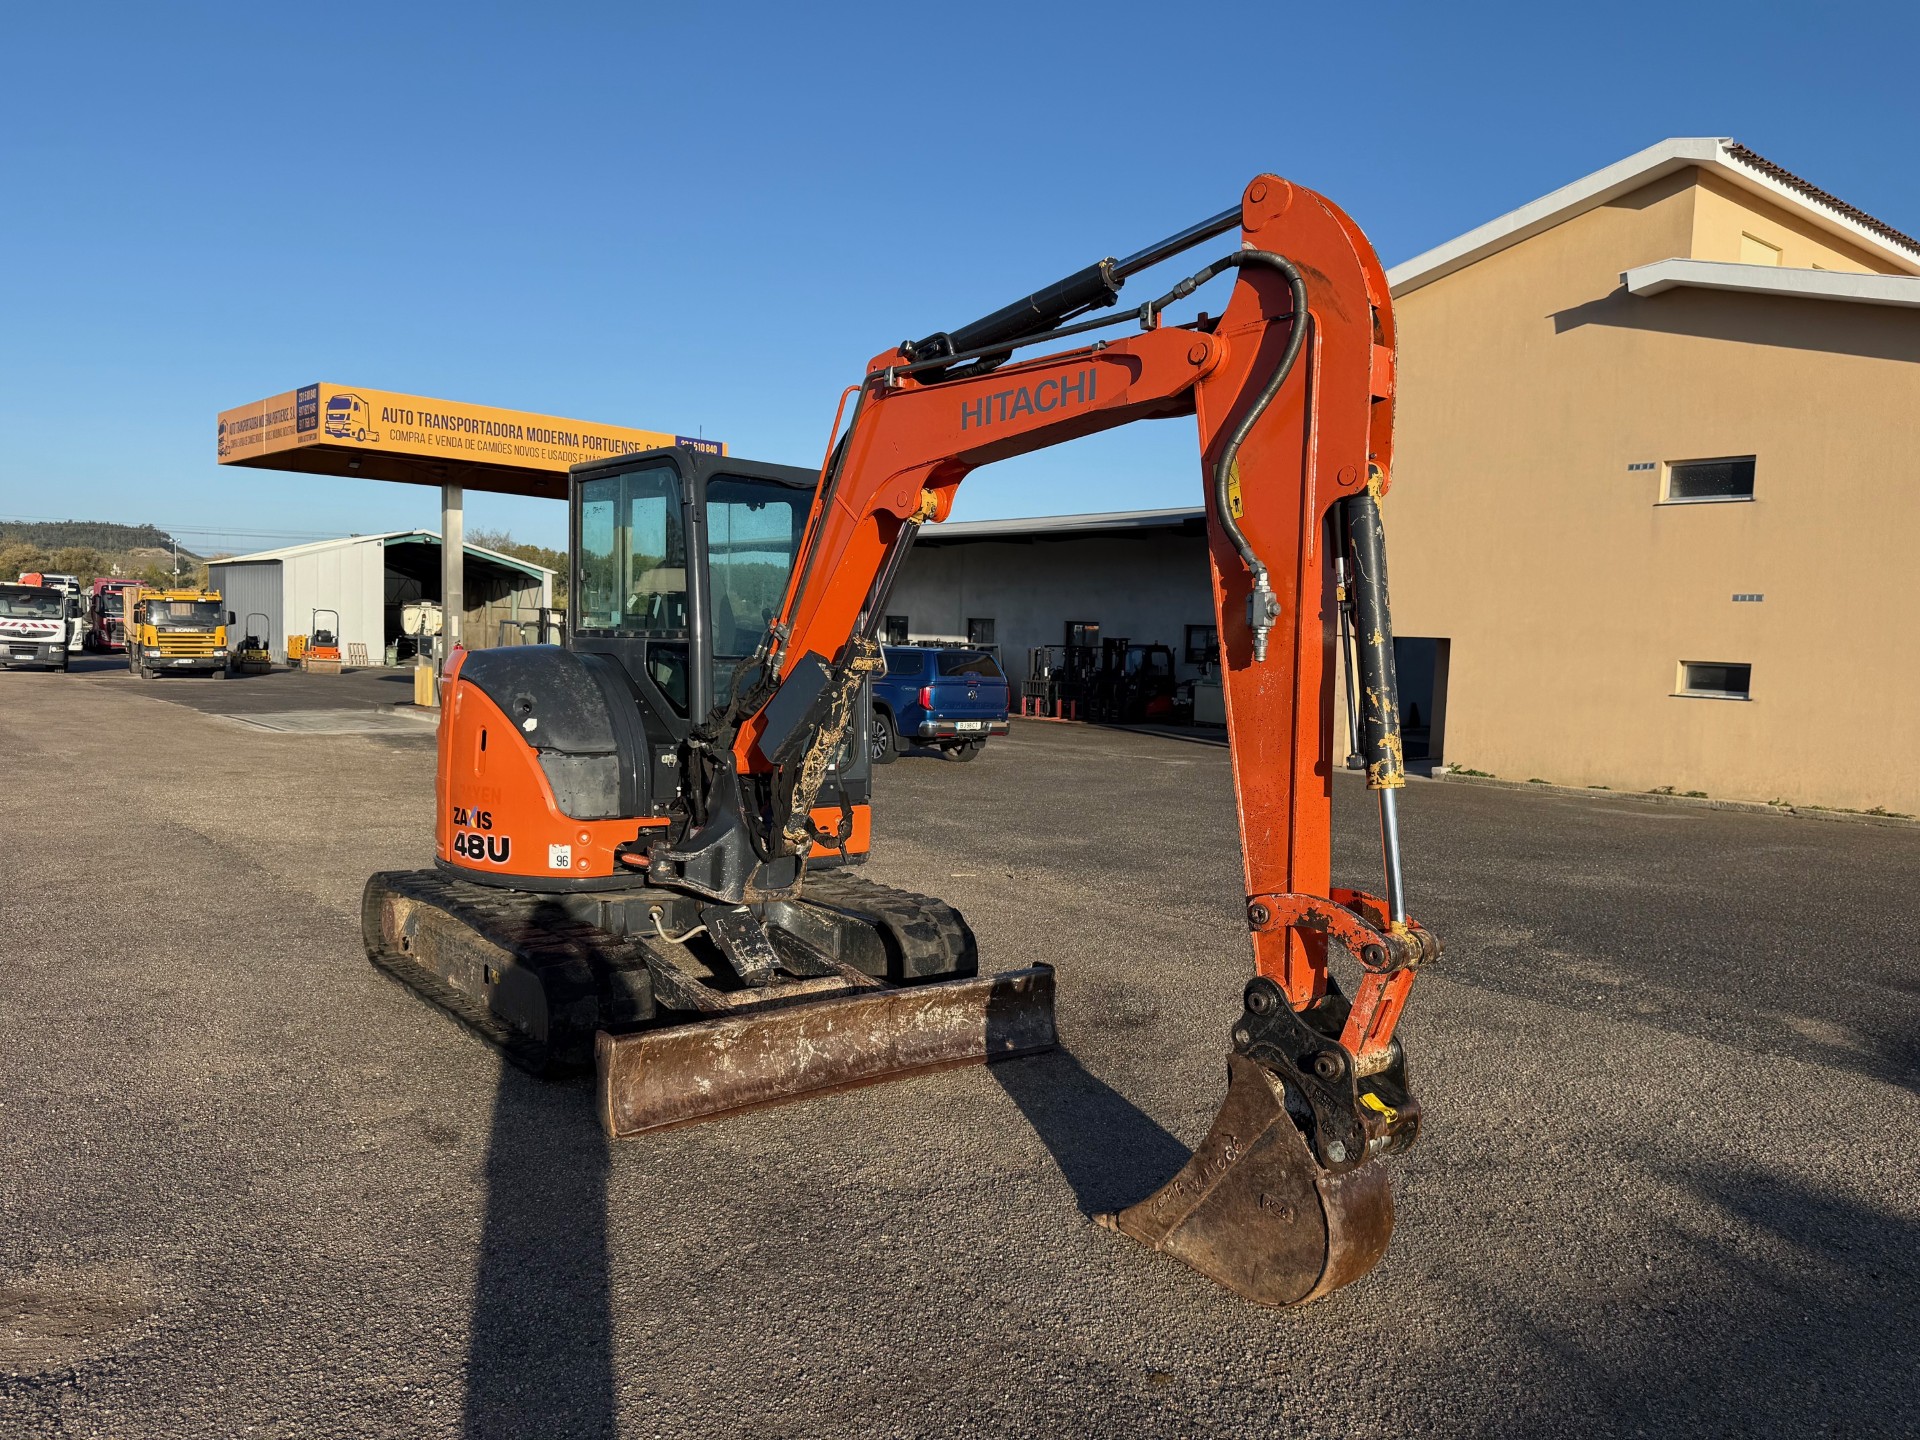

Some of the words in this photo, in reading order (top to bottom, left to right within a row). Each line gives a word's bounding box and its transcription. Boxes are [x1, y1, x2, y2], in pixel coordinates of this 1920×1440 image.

[961, 368, 1097, 431] HITACHI
[381, 406, 414, 426] AUTO
[417, 411, 523, 440] TRANSPORTADORA
[526, 427, 579, 448] MODERNA
[582, 434, 640, 454] PORTUENSE
[389, 429, 426, 444] COMPRA
[427, 434, 433, 445] E
[435, 435, 463, 449] VENDA
[465, 438, 475, 450] DE
[477, 440, 512, 455] CAMIÕES
[514, 445, 539, 458] NOVOS
[541, 448, 546, 459] E
[547, 450, 578, 463] USADOS
[693, 441, 705, 453] 510
[706, 444, 718, 454] 840
[453, 806, 493, 830] ZAXIS
[453, 831, 510, 863] 48U
[556, 855, 569, 867] 96
